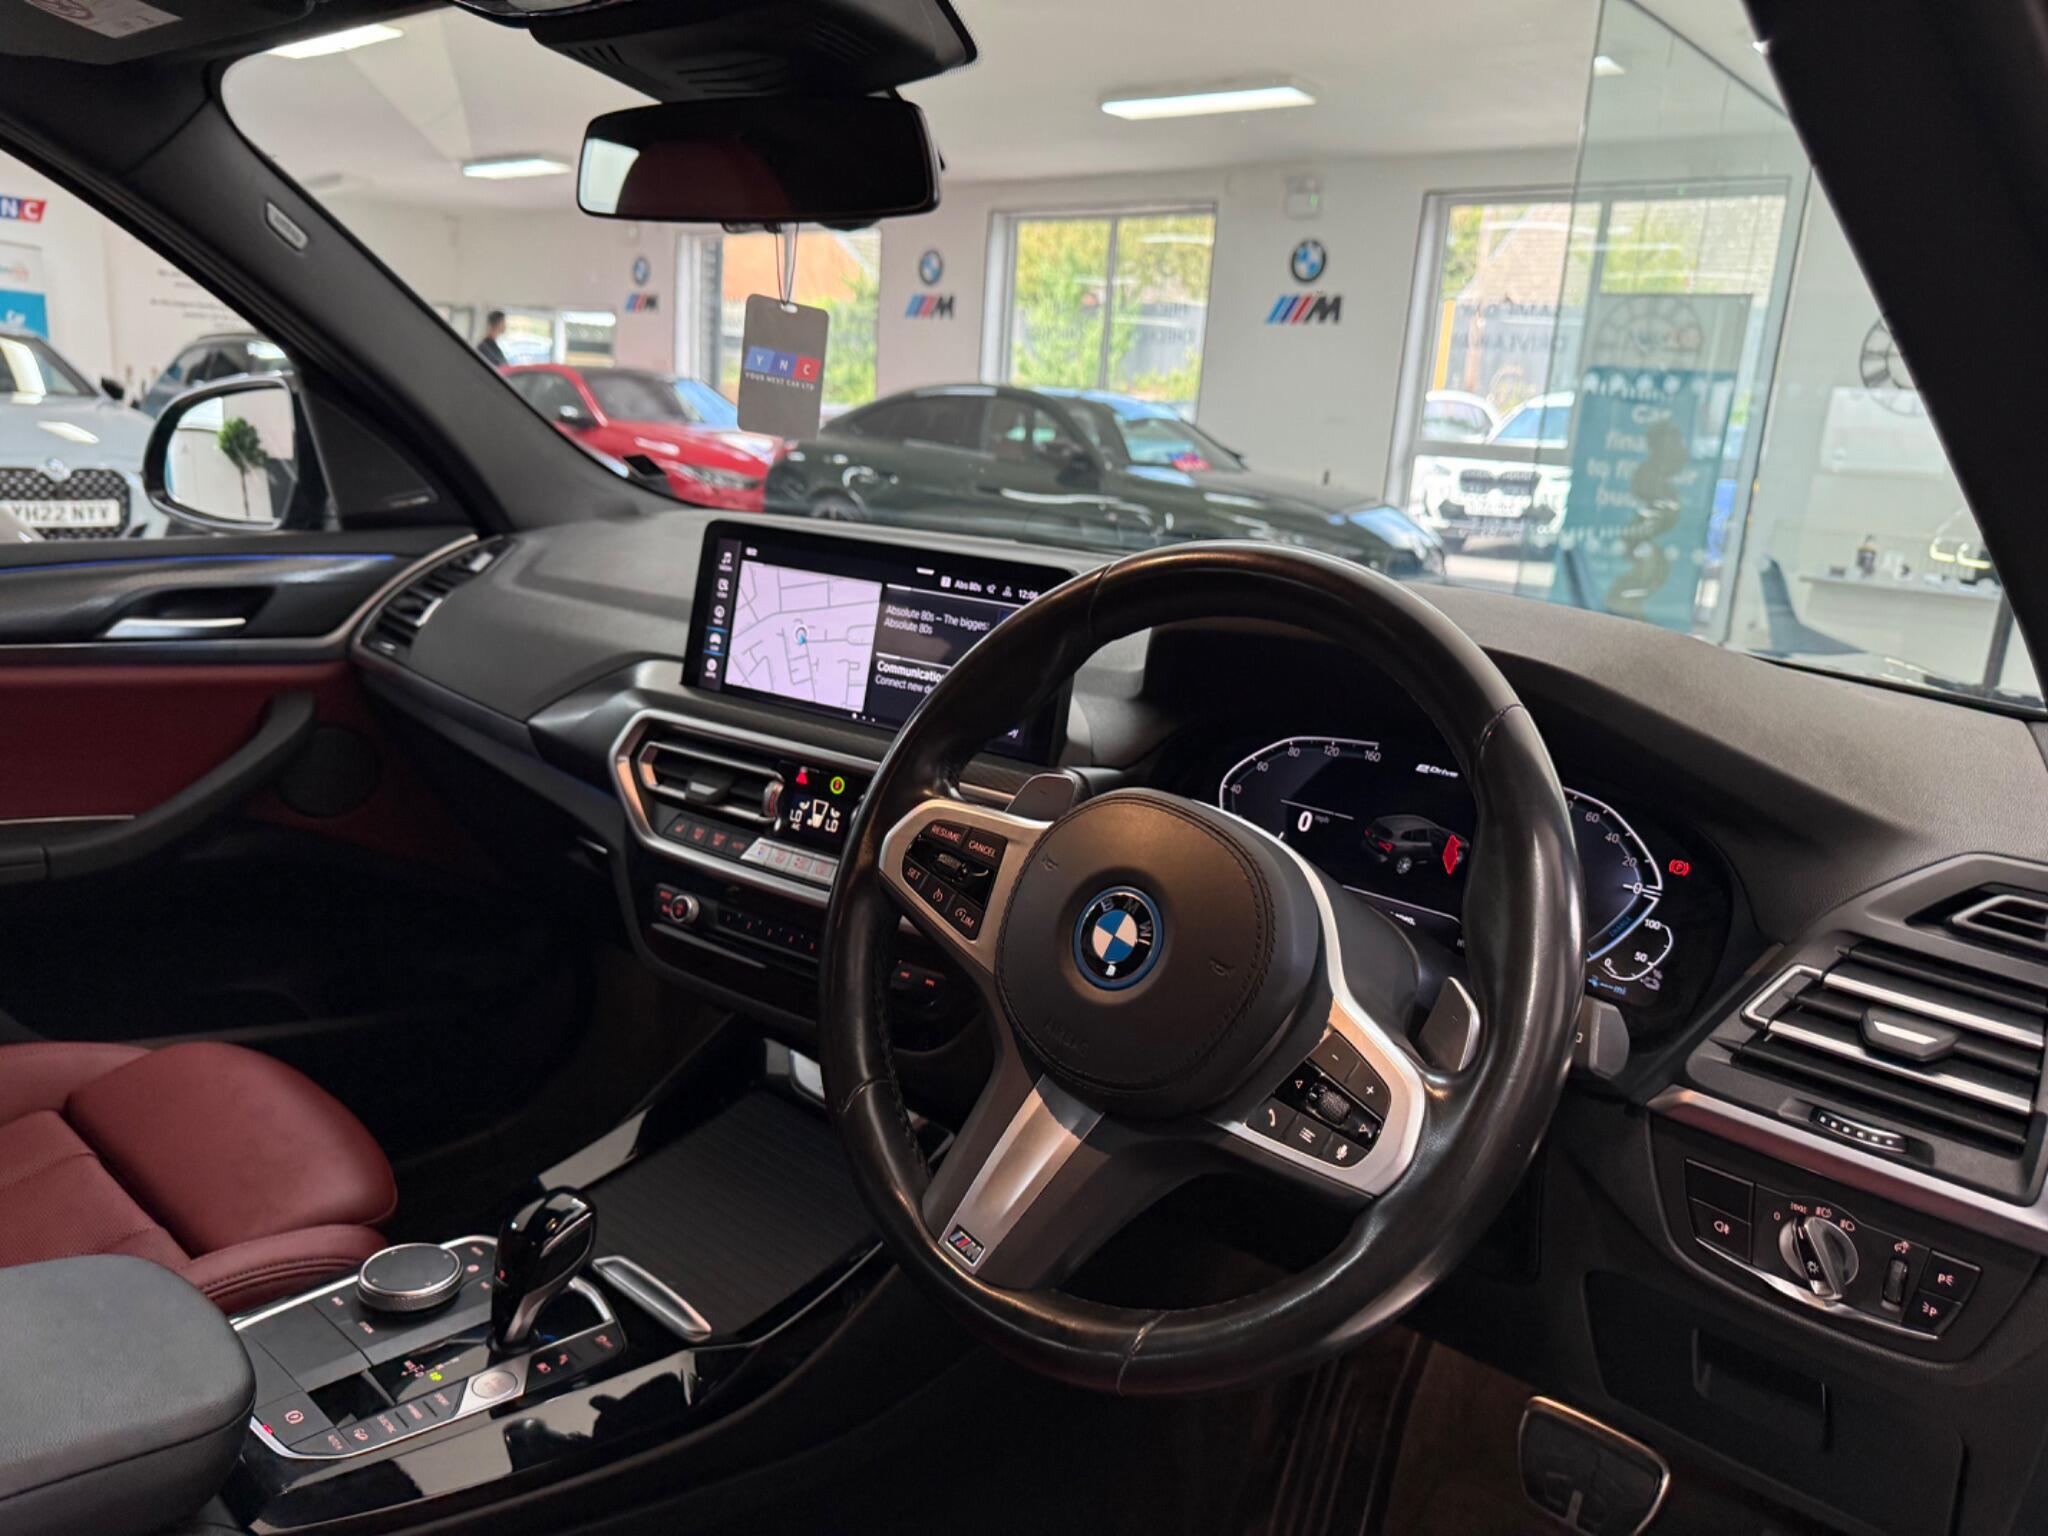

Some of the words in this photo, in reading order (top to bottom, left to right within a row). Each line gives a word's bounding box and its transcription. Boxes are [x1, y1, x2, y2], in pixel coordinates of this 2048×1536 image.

[886, 604, 921, 620] Absolute
[921, 609, 935, 622] 80s
[944, 613, 959, 627] The
[884, 616, 917, 632] Absolute
[918, 621, 933, 635] 80s
[877, 659, 945, 683] Communicatio
[875, 674, 907, 690] Connect
[907, 682, 924, 694] new
[1287, 747, 1300, 758] 80
[1323, 745, 1340, 757] 120
[1364, 750, 1382, 763] 160
[1230, 784, 1242, 794] 40
[1297, 810, 1313, 833] 0
[1585, 811, 1600, 823] 60
[931, 824, 961, 842] RESUME
[1605, 832, 1620, 844] 40
[968, 840, 996, 858] CANCEL
[1622, 857, 1637, 868] 20
[907, 867, 921, 881] SET
[1632, 883, 1643, 896] 0
[1644, 918, 1661, 930] 100
[1634, 951, 1648, 963] 50
